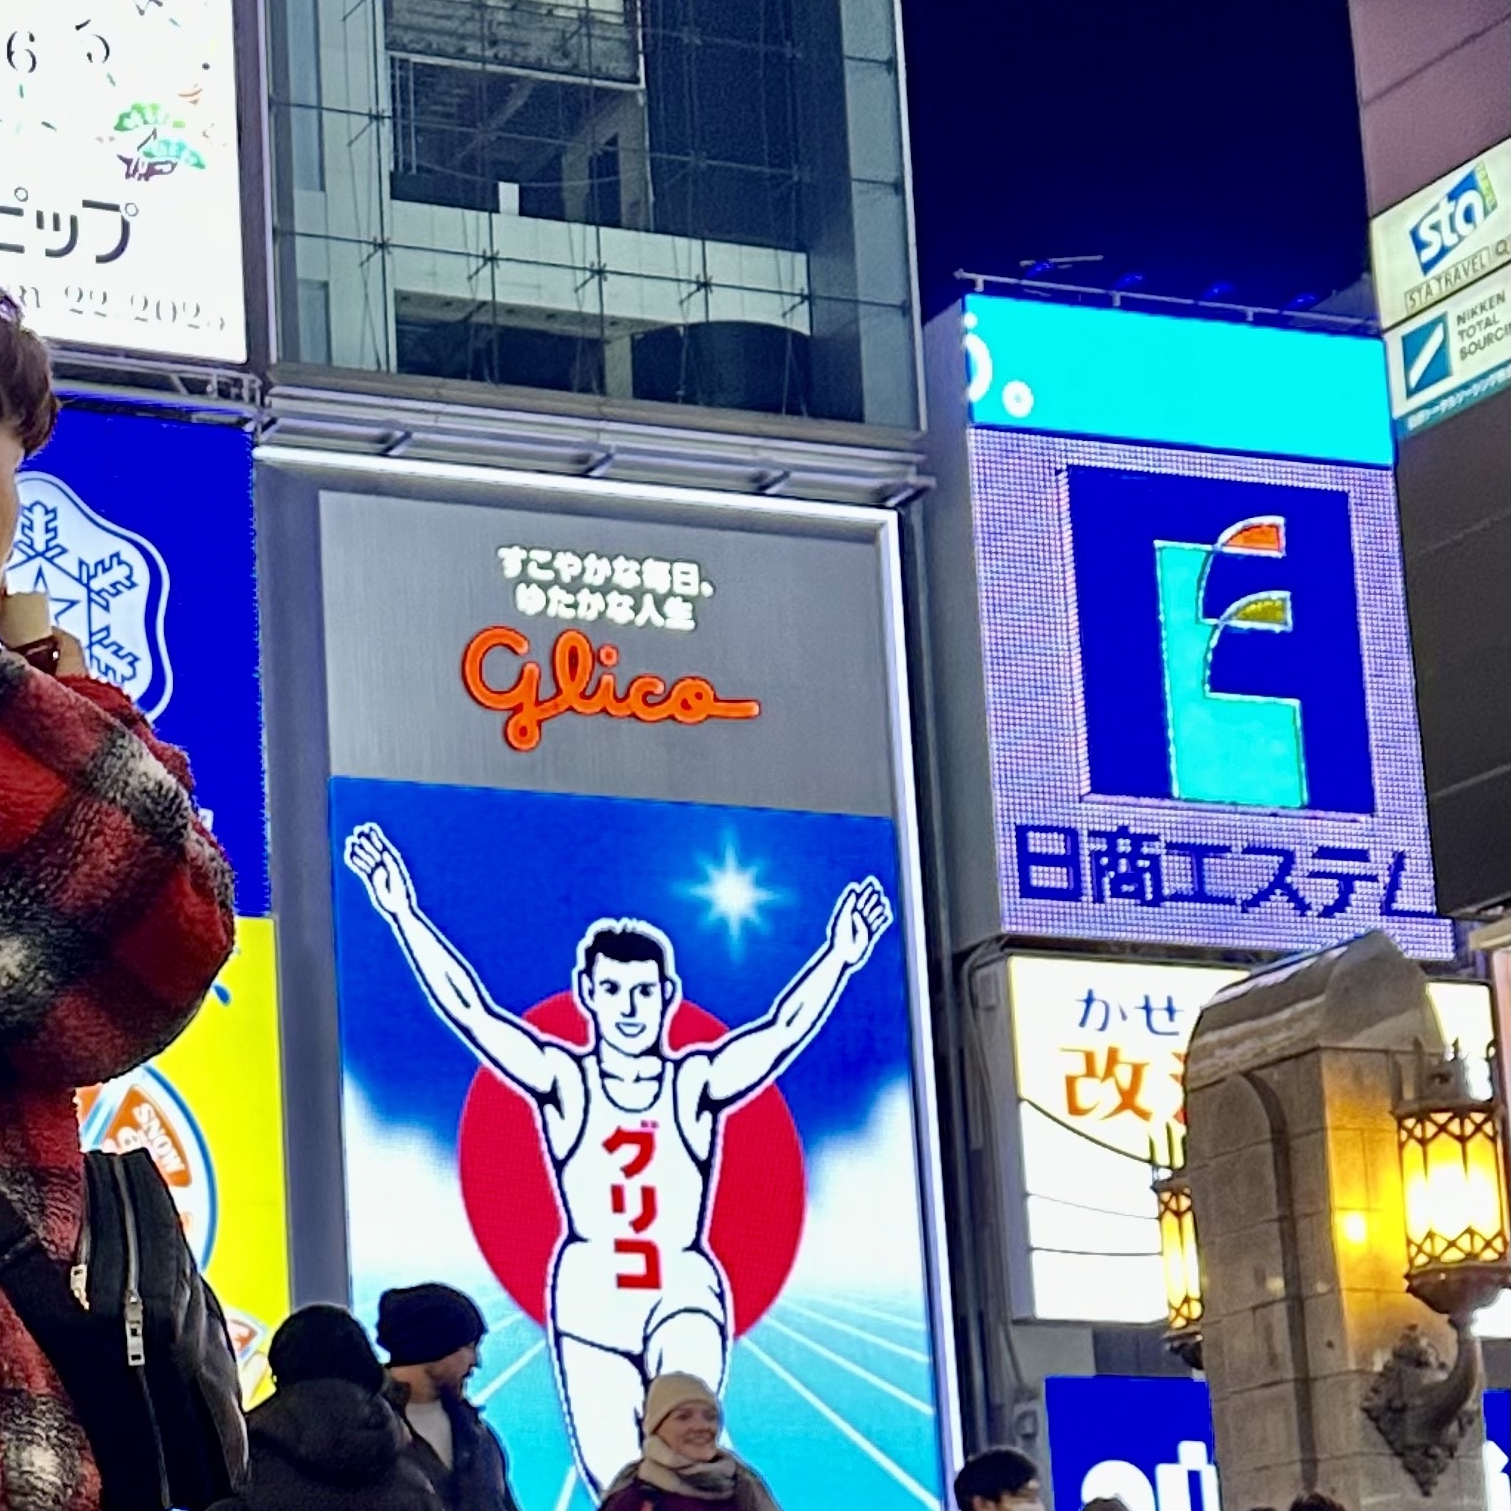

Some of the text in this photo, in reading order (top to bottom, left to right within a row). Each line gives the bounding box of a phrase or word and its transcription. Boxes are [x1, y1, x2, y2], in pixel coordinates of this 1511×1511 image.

[1418, 188, 1485, 264] sta
[1458, 313, 1500, 343] TOTAL
[461, 625, 761, 752] Glico
[1060, 1044, 1187, 1124] 改
[602, 1120, 662, 1290] グリコ
